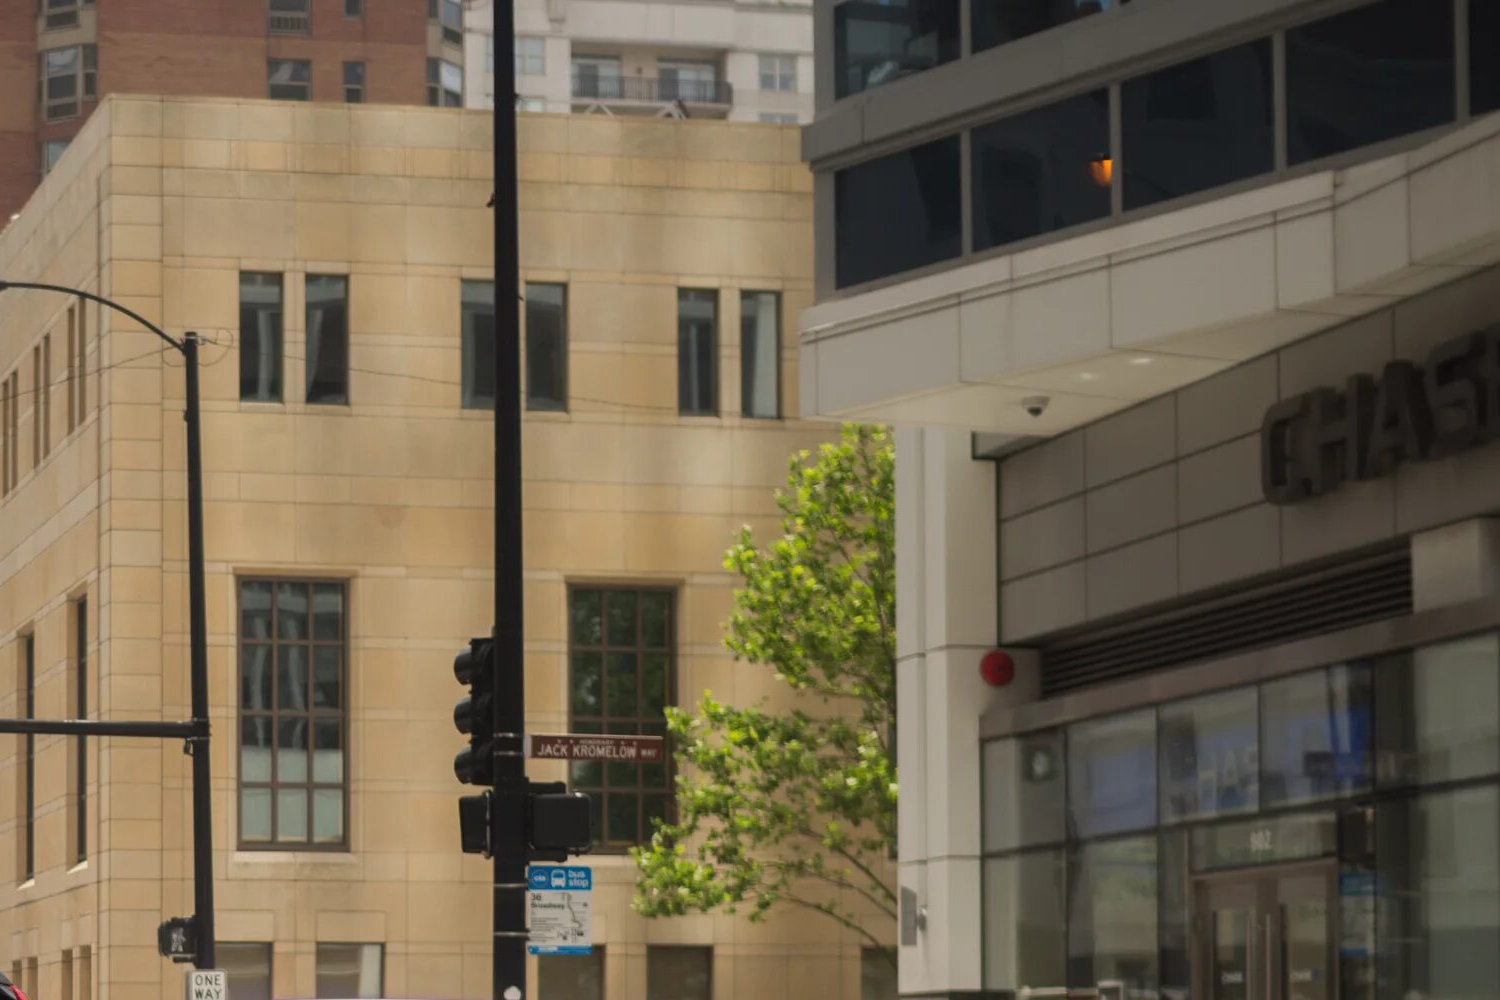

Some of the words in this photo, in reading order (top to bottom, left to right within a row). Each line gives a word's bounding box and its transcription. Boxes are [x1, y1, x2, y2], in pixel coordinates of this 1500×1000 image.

[537, 744, 569, 757] JACK
[572, 744, 638, 760] KROMELOW
[641, 748, 658, 759] WAY
[567, 869, 587, 879] bus
[568, 879, 589, 889] stop
[194, 974, 222, 987] ONE
[194, 988, 222, 1000] WAY
